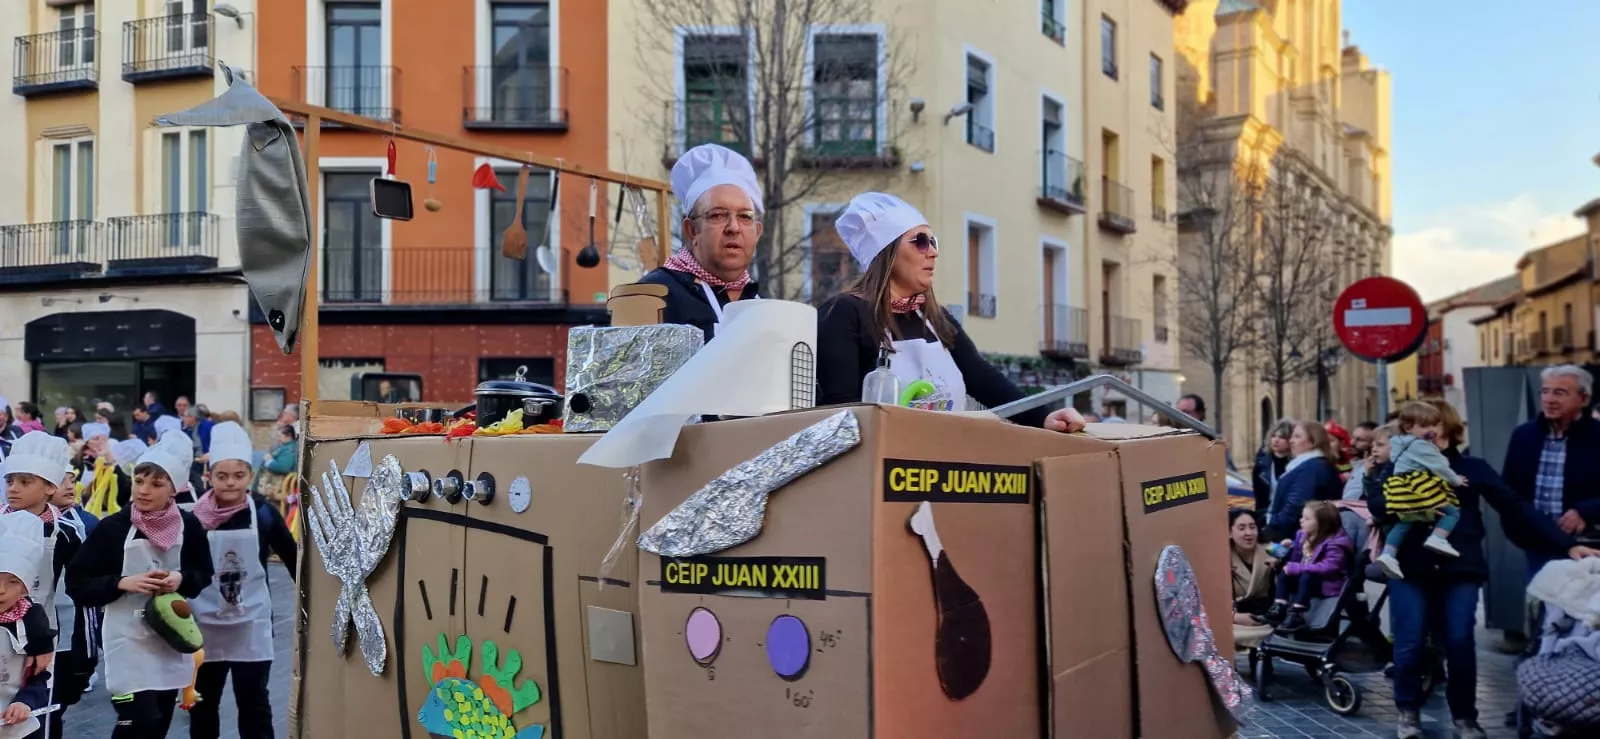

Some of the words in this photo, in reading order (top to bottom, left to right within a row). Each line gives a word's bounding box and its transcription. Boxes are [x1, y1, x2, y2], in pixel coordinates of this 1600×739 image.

[889, 467, 940, 492] CEIP
[942, 470, 991, 493] JUAN
[993, 472, 1027, 494] XXIII
[1144, 485, 1165, 506] CEIP
[1165, 481, 1188, 501] JUAN
[665, 562, 708, 585] CEIP
[711, 563, 767, 587] JUAN
[771, 564, 819, 589] XXIII
